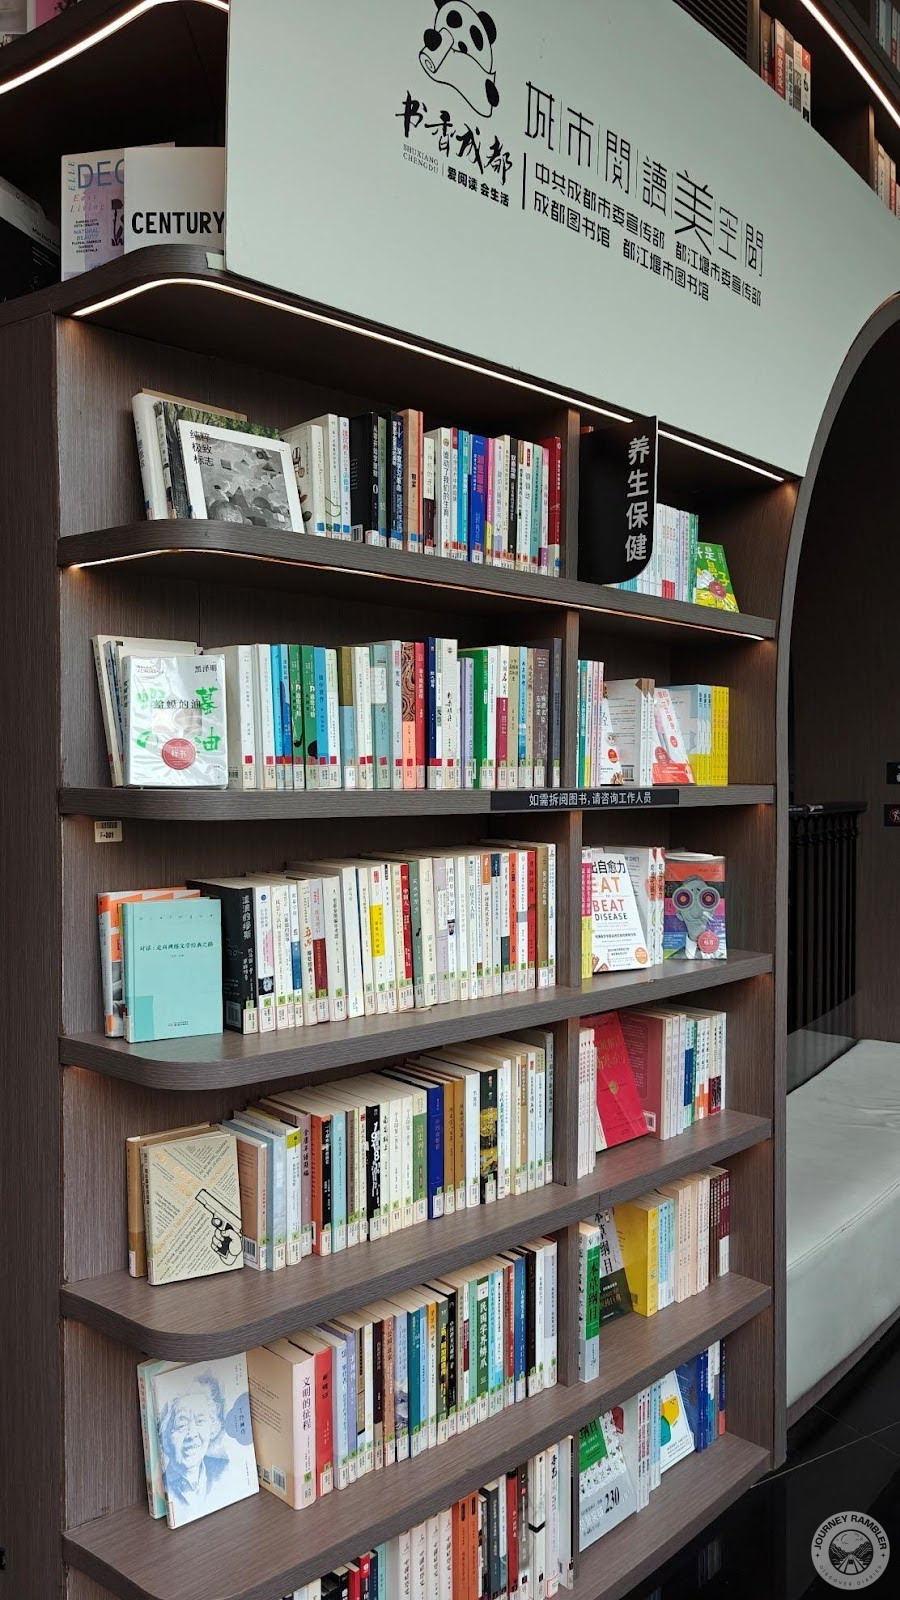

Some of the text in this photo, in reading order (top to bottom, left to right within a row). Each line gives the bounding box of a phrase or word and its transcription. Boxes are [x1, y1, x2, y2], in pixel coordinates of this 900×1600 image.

[395, 90, 513, 186] 书香成都
[402, 144, 439, 166] SHUXIANG
[402, 153, 439, 174] CHENGDU
[447, 165, 510, 208] 爱阅读 会生活
[132, 211, 225, 234] CENTURY
[534, 161, 762, 307] 中共成都市委宣传部 都江堰市委宣传部
[533, 190, 710, 302] 成都图书馆 都江堰市图书馆
[625, 434, 651, 563] 养生保健
[194, 664, 217, 674] 黑泽明
[591, 876, 621, 894] EAT
[593, 899, 625, 912] BEAT
[594, 912, 628, 922] DISEASE
[588, 1262, 599, 1322] 本草纲目
[302, 1376, 312, 1432] 文明的征程
[605, 1486, 620, 1514] 230
